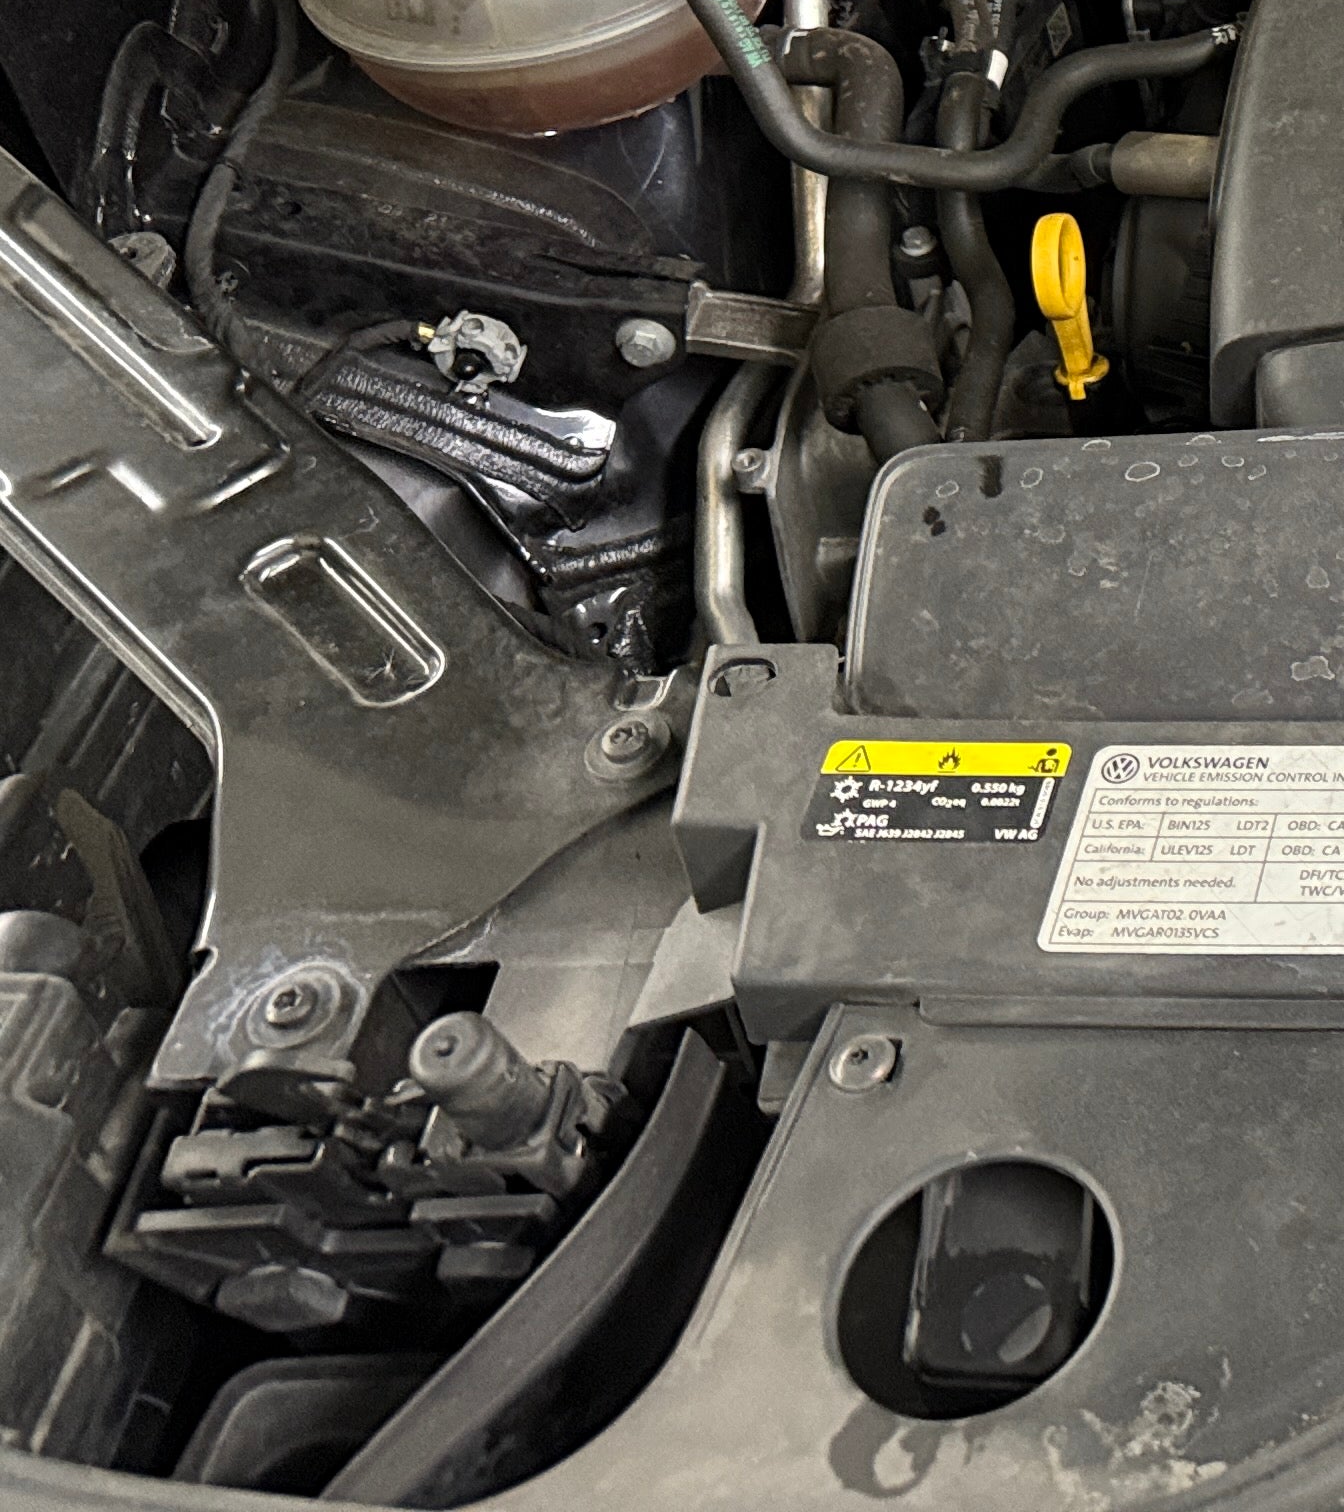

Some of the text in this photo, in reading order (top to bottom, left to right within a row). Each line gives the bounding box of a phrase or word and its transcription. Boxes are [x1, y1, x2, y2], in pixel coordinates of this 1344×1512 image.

[1148, 757, 1269, 769] VOLKSWAGEN
[1144, 772, 1195, 782] VEHICLE
[1199, 772, 1264, 782] EMISSION
[1267, 772, 1328, 782] CONTROL
[869, 779, 939, 795] R-1234yf
[1008, 782, 1025, 796] kg
[863, 799, 896, 808] GWP 4
[1099, 795, 1162, 806] Conforms
[1165, 797, 1179, 806] to
[854, 814, 889, 827] PAG
[1092, 819, 1114, 830] U.S.
[1168, 820, 1269, 831] BIN125 LDT2
[1288, 820, 1321, 831] OBD:
[854, 828, 876, 838] SAE
[994, 828, 1038, 840] VW AG
[1161, 845, 1256, 856] ULEV125 LDT
[1282, 845, 1315, 856] OBD:
[1322, 846, 1340, 856] CA
[1074, 876, 1094, 886] No
[1096, 876, 1180, 890] adjustments
[1064, 908, 1110, 922] Group:
[1058, 926, 1094, 939] Evap:
